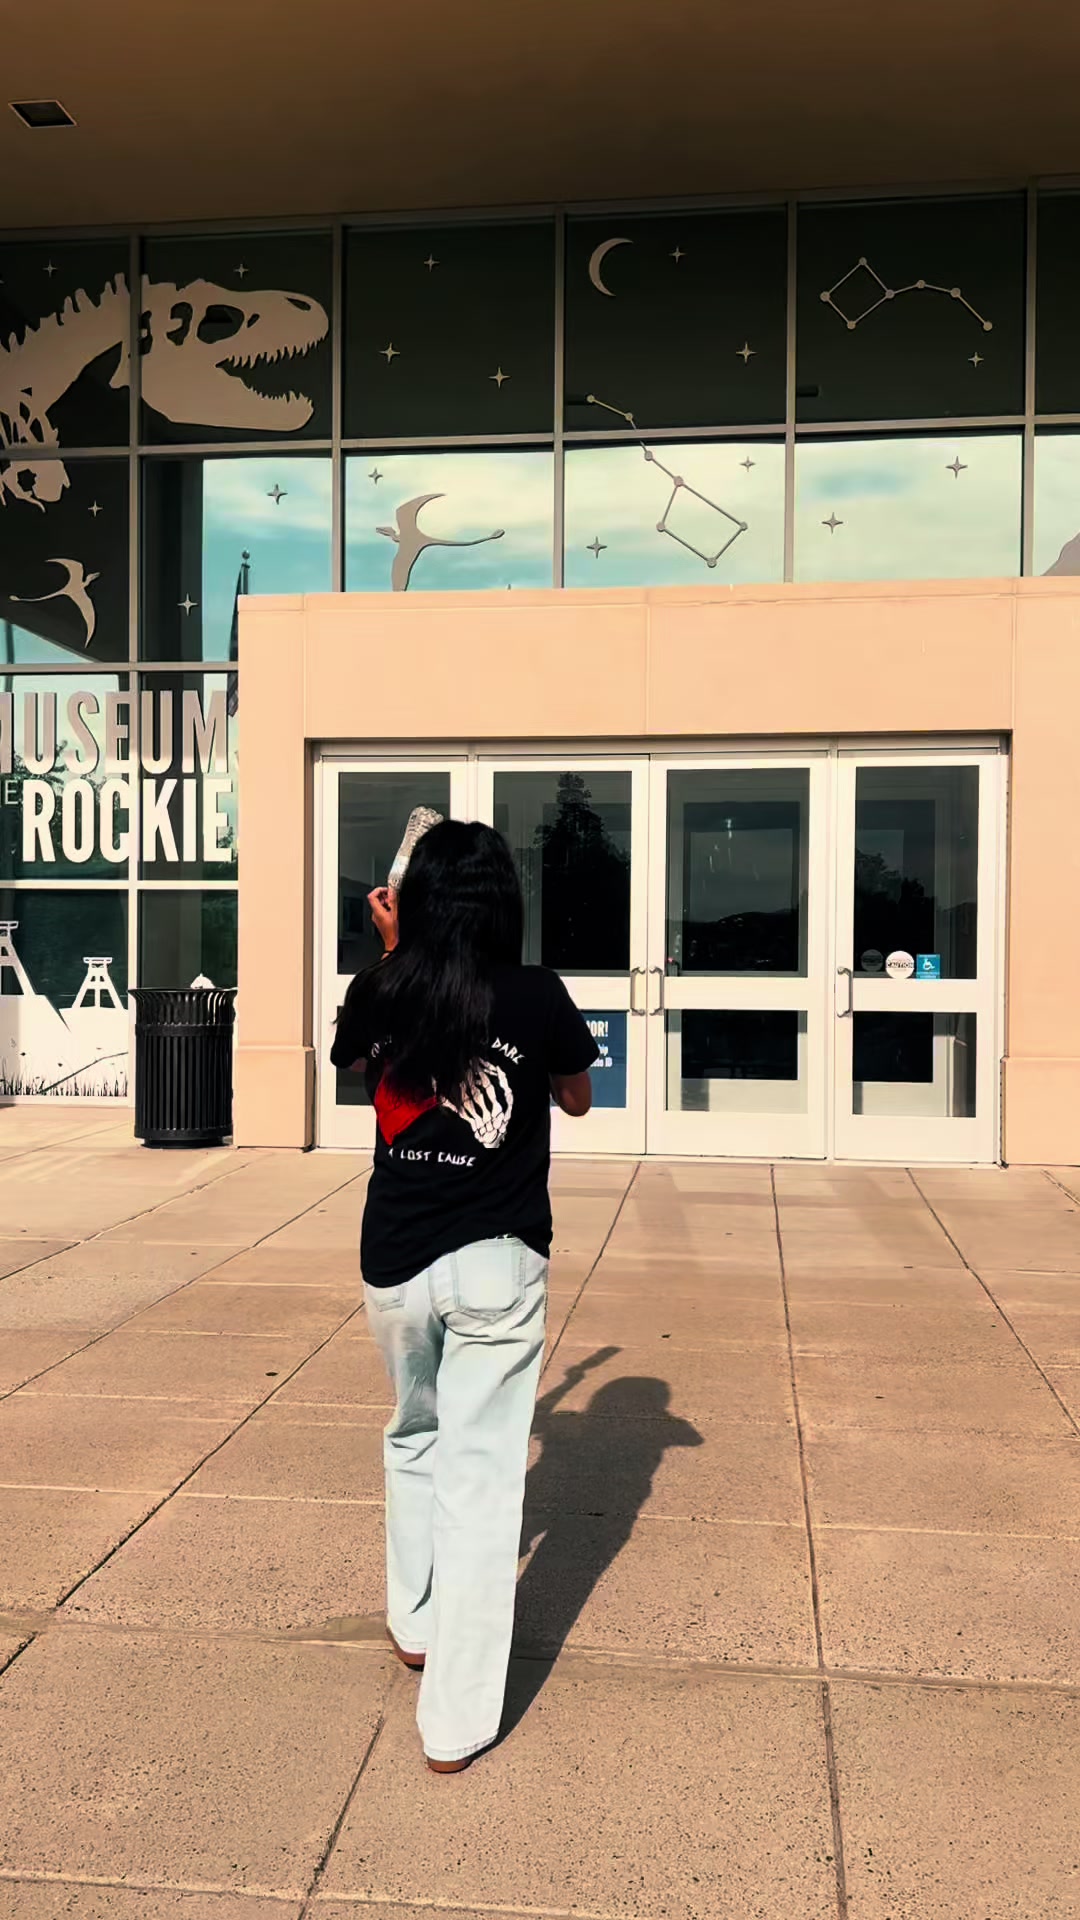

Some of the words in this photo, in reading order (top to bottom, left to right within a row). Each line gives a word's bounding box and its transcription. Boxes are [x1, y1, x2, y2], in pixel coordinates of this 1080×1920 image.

[0, 690, 228, 774] USEUM
[586, 1020, 609, 1037] OR!
[400, 1149, 432, 1161] LOST
[437, 1151, 477, 1167] CAUSE
